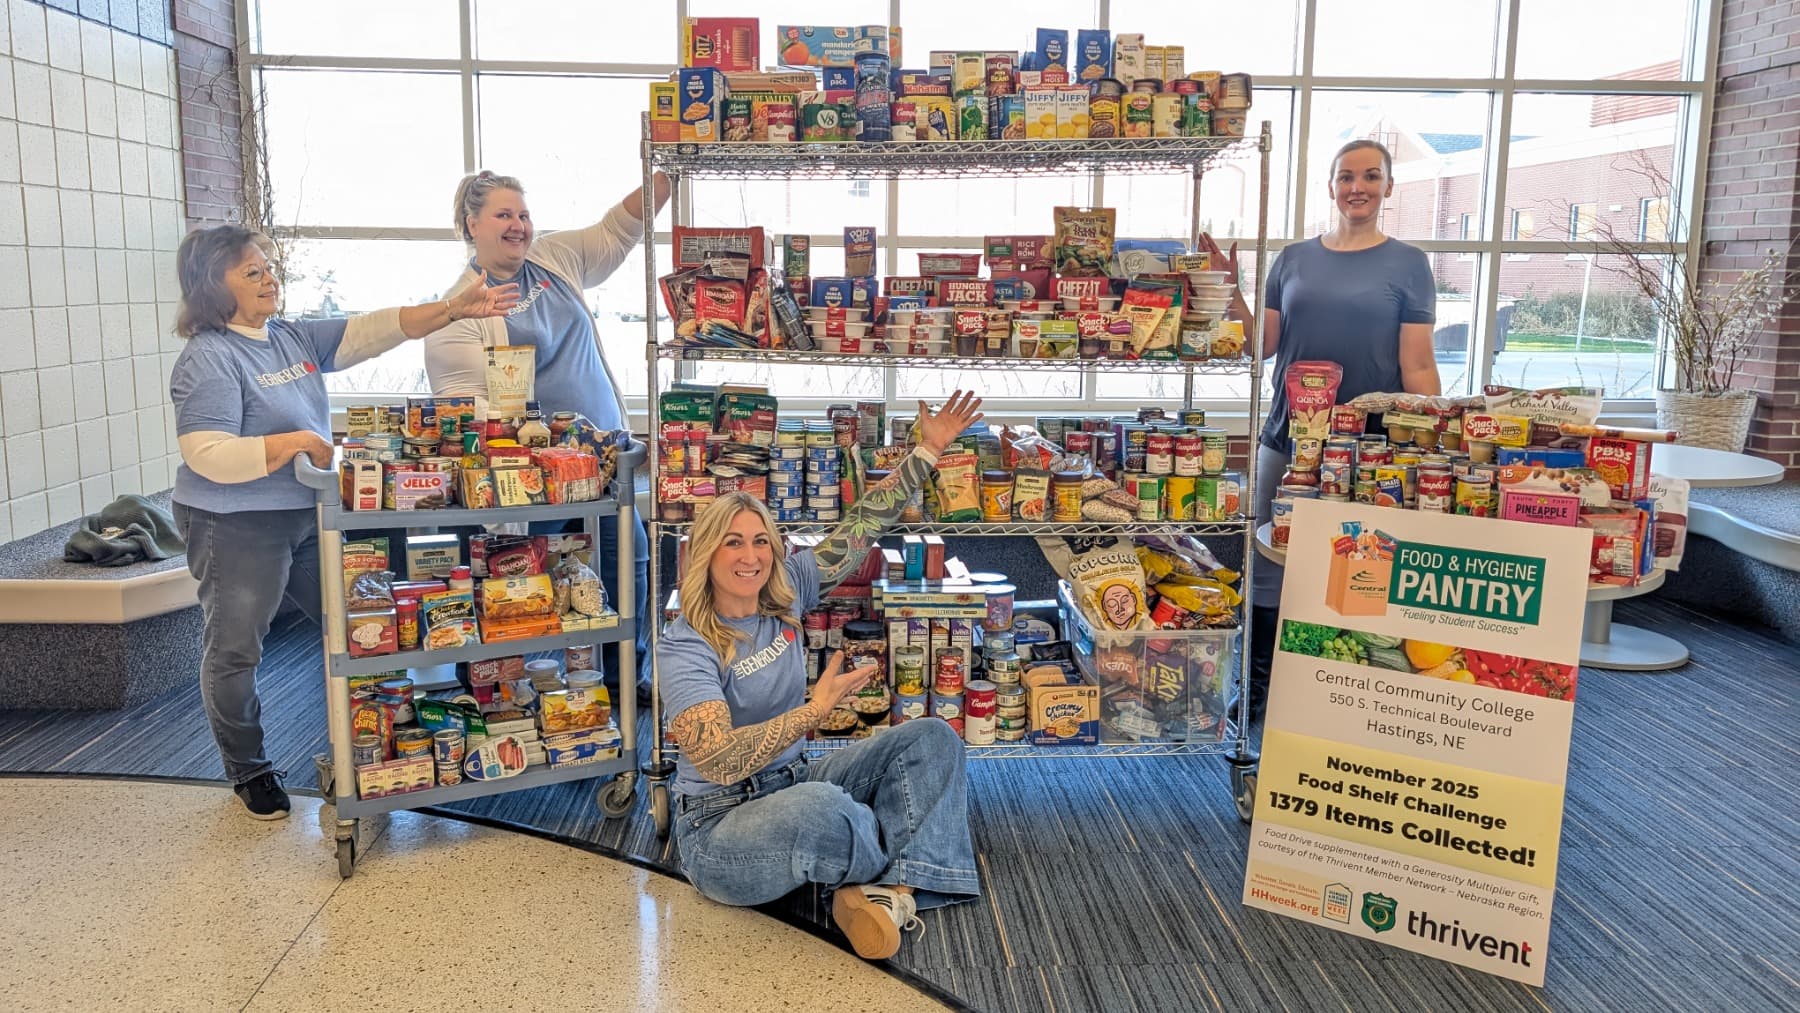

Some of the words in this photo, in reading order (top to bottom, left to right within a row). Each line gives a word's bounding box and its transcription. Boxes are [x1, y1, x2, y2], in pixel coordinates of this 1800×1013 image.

[696, 35, 711, 58] RITZ
[770, 94, 793, 104] VALLEY
[1026, 93, 1056, 102] JIFFY
[1058, 93, 1088, 102] JIFFY
[820, 114, 834, 125] V8
[849, 229, 868, 239] POP
[946, 290, 988, 302] JACK
[958, 314, 984, 324] Snack
[964, 321, 984, 329] pack
[1079, 315, 1104, 327] Snack
[1084, 324, 1104, 334] pack
[1296, 396, 1328, 405] QUINOA
[1510, 398, 1550, 410] Orchard
[1552, 400, 1578, 415] Valley
[664, 424, 688, 433] Snack
[1468, 418, 1498, 429] Snack
[1473, 426, 1497, 436] pack
[1502, 469, 1513, 478] 15
[404, 478, 442, 489] JELL-O
[662, 479, 689, 491] Snack
[1380, 479, 1400, 488] TOMATO
[668, 488, 689, 497] pack
[1516, 504, 1568, 518] PINEAPPLE
[416, 556, 437, 564] VARIETY
[438, 554, 455, 563] PACK
[1069, 552, 1140, 579] POPCORN
[1400, 549, 1443, 568] FOOD
[1448, 555, 1460, 572] &
[1465, 557, 1538, 582] HYGIENE
[1397, 569, 1536, 617] PANTRY
[432, 607, 469, 622] Creations
[1438, 614, 1475, 629] Student
[474, 662, 499, 674] Snack
[480, 669, 498, 678] pack
[1315, 670, 1370, 690] Central
[1374, 680, 1467, 711] Community
[1471, 697, 1534, 722] College
[359, 709, 378, 721] Lucky
[1046, 704, 1082, 718] Creamy
[1329, 692, 1354, 707] 550
[1358, 698, 1368, 710] S.
[1373, 700, 1436, 722] Technical
[1440, 713, 1512, 737] Boulevard
[354, 718, 378, 729] Charms
[1367, 719, 1438, 747] Hastings,
[1443, 734, 1466, 750] NE
[1326, 756, 1426, 788] November
[1431, 778, 1479, 800] 2025
[1298, 772, 1343, 794] Food
[1348, 784, 1399, 806] Shelf
[1404, 796, 1507, 830] Challenge
[1269, 791, 1318, 816] 1379
[1325, 804, 1394, 834] Items
[1401, 822, 1536, 868] Collected!
[1265, 828, 1288, 840] Food
[1288, 834, 1312, 846] Drive
[1314, 841, 1380, 864] supplemented
[1381, 858, 1400, 869] with
[1412, 864, 1464, 885] Generosity
[1467, 878, 1516, 898] Multiplier
[1518, 892, 1540, 906] Gift,
[1258, 840, 1296, 856] courtesy
[1309, 852, 1324, 862] the
[1326, 856, 1363, 872] Thrivent
[1365, 866, 1404, 882] Member
[1406, 876, 1446, 894] Network
[1456, 890, 1505, 909] Nebraska
[1508, 904, 1544, 920] Region.
[1252, 888, 1320, 916] HHweek.org
[1408, 910, 1532, 968] thrivent
